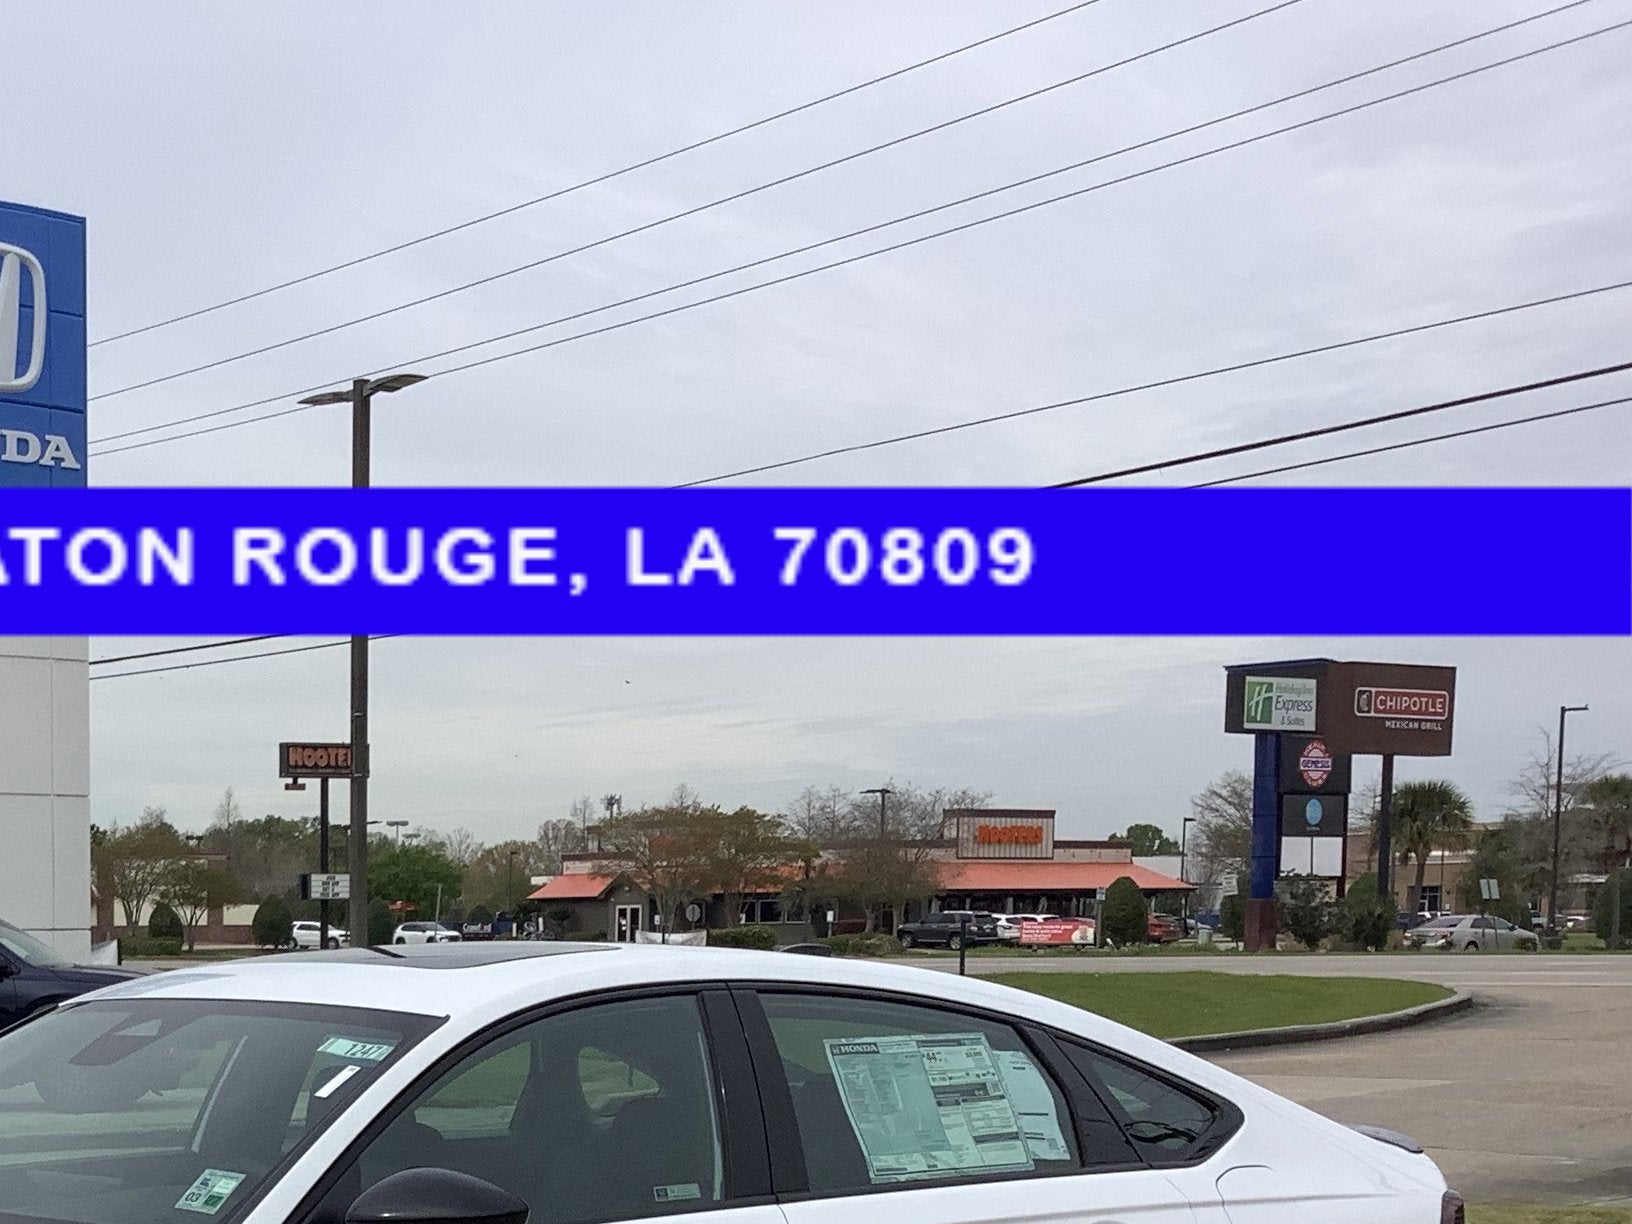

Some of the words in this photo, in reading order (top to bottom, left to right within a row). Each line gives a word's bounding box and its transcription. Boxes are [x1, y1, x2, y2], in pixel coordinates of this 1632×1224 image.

[1275, 695, 1313, 714] Express
[1376, 694, 1444, 713] CHIPOTLE
[1385, 720, 1419, 730] MEXICAN
[1420, 722, 1443, 731] GRILL
[289, 747, 352, 768] HOOTE
[344, 1043, 384, 1058] 1247
[840, 1043, 879, 1054] HONDA
[184, 1191, 202, 1203] 03
